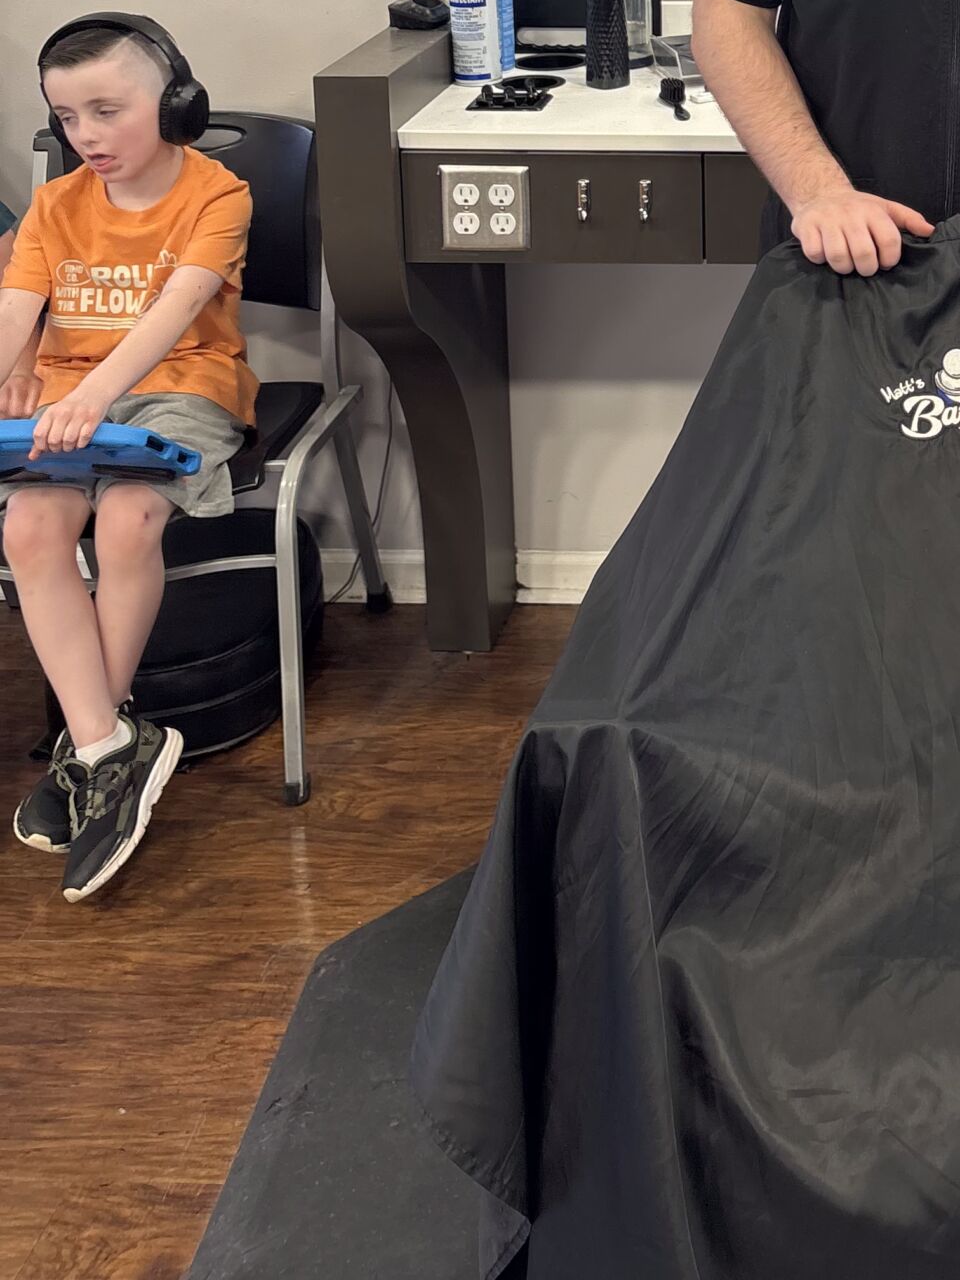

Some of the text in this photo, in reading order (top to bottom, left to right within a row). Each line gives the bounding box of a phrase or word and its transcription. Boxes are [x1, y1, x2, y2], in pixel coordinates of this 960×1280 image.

[56, 286, 80, 298] WITH
[80, 287, 147, 315] FLOW
[57, 300, 76, 313] THE
[880, 377, 926, 404] Matt's
